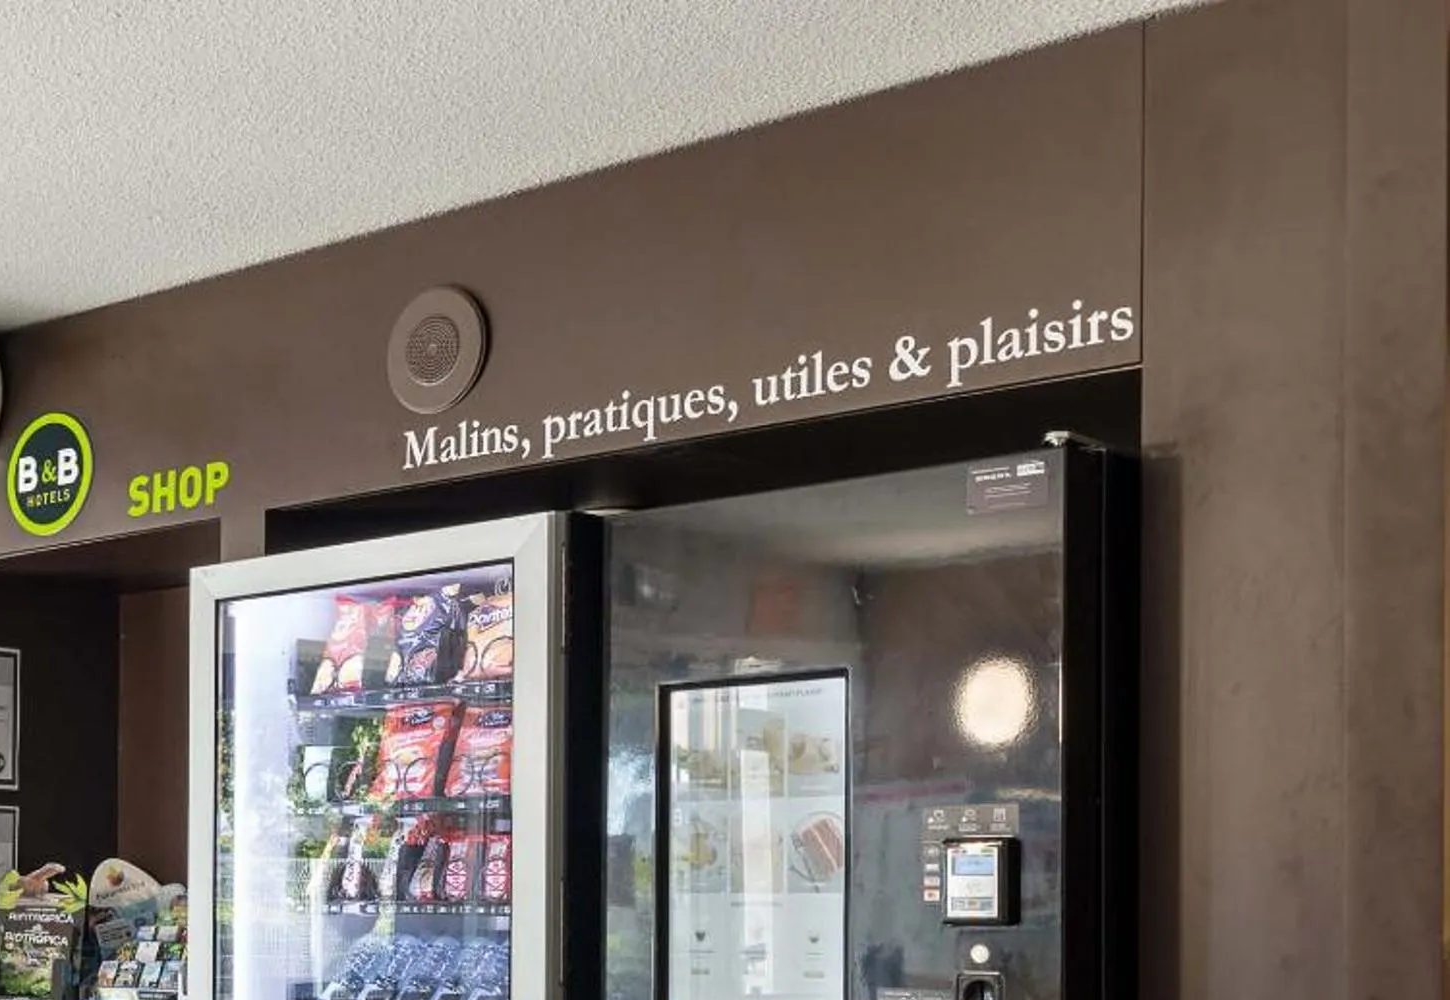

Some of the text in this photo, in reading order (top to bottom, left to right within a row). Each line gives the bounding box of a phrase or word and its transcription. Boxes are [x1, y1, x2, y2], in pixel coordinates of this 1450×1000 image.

[402, 299, 1134, 470] Malins, pratiques, utiles & plaisirs
[26, 488, 71, 509] HOTELS
[127, 461, 230, 518] SHOP
